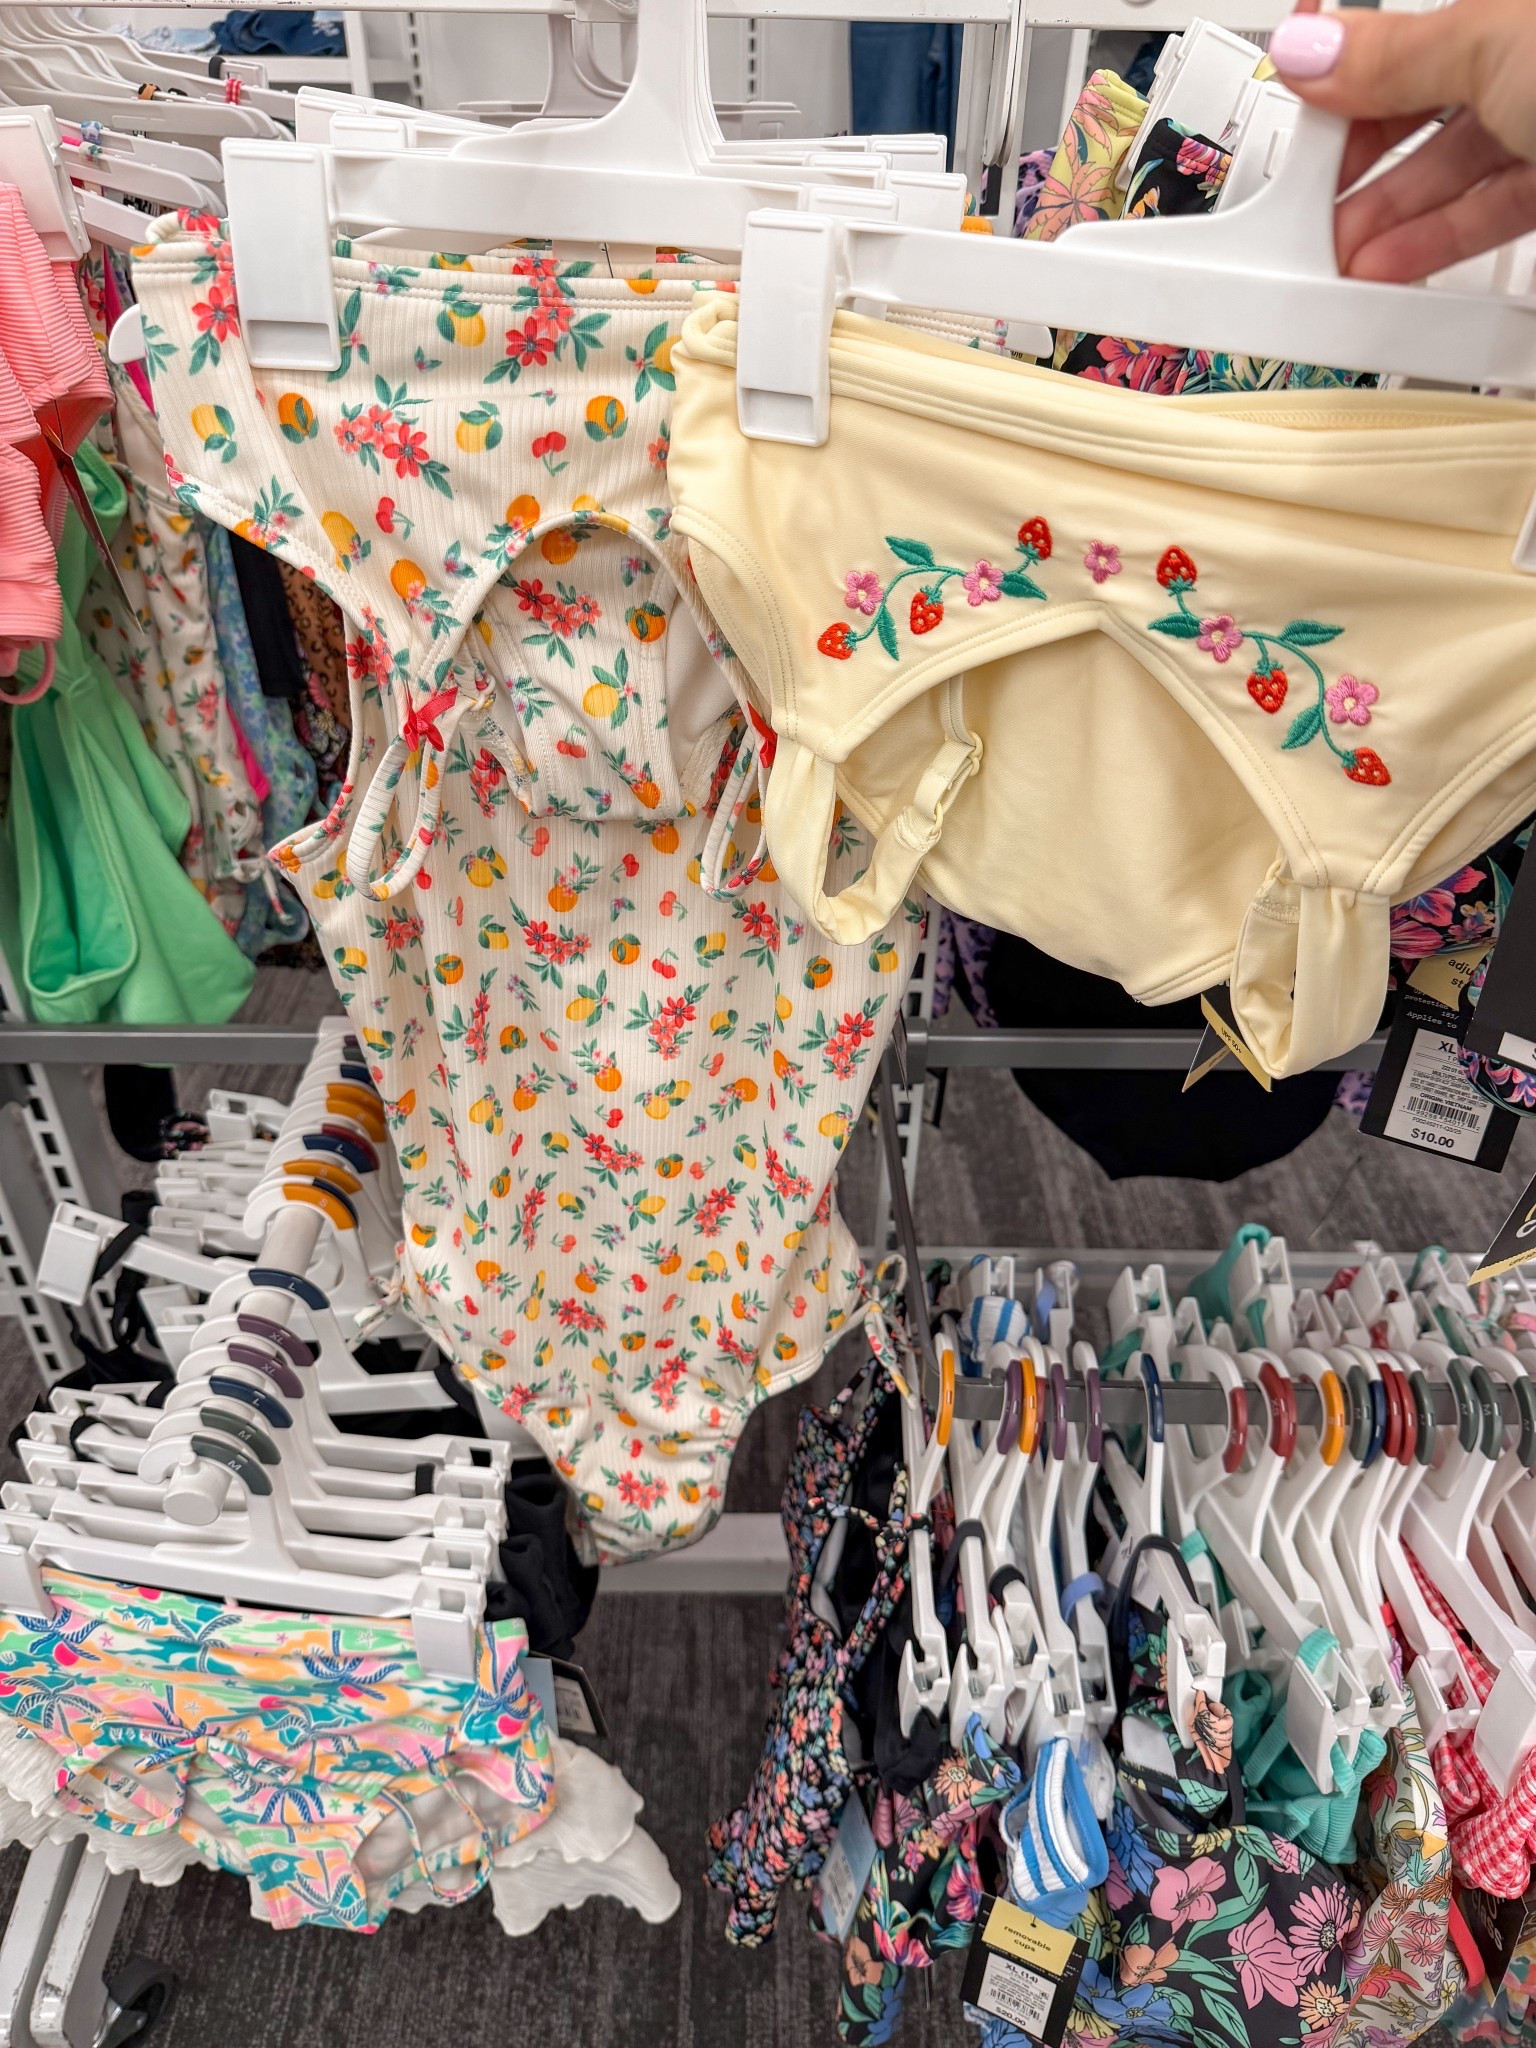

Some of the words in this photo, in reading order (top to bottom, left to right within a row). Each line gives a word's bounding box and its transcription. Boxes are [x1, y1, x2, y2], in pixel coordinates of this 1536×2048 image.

[1406, 1010, 1442, 1025] Applies
[1447, 1021, 1457, 1029] to
[1438, 1040, 1457, 1054] XL
[1420, 1092, 1444, 1103] ORIGIN:
[1445, 1100, 1472, 1111] VIETNAM
[1411, 1128, 1455, 1148] $10.00
[320, 1168, 328, 1176] S
[319, 1199, 328, 1208] S
[288, 1282, 296, 1292] L
[269, 1332, 283, 1345] XL
[261, 1363, 276, 1376] XL
[252, 1398, 260, 1407] L
[1483, 1404, 1490, 1416] M
[238, 1430, 252, 1441] M
[227, 1459, 242, 1471] M
[1004, 1925, 1051, 1952] removable
[1014, 1939, 1035, 1952] cups
[1005, 1963, 1018, 1974] XL
[1021, 1971, 1038, 1983] (14)
[996, 2006, 1026, 2026] $20.00
